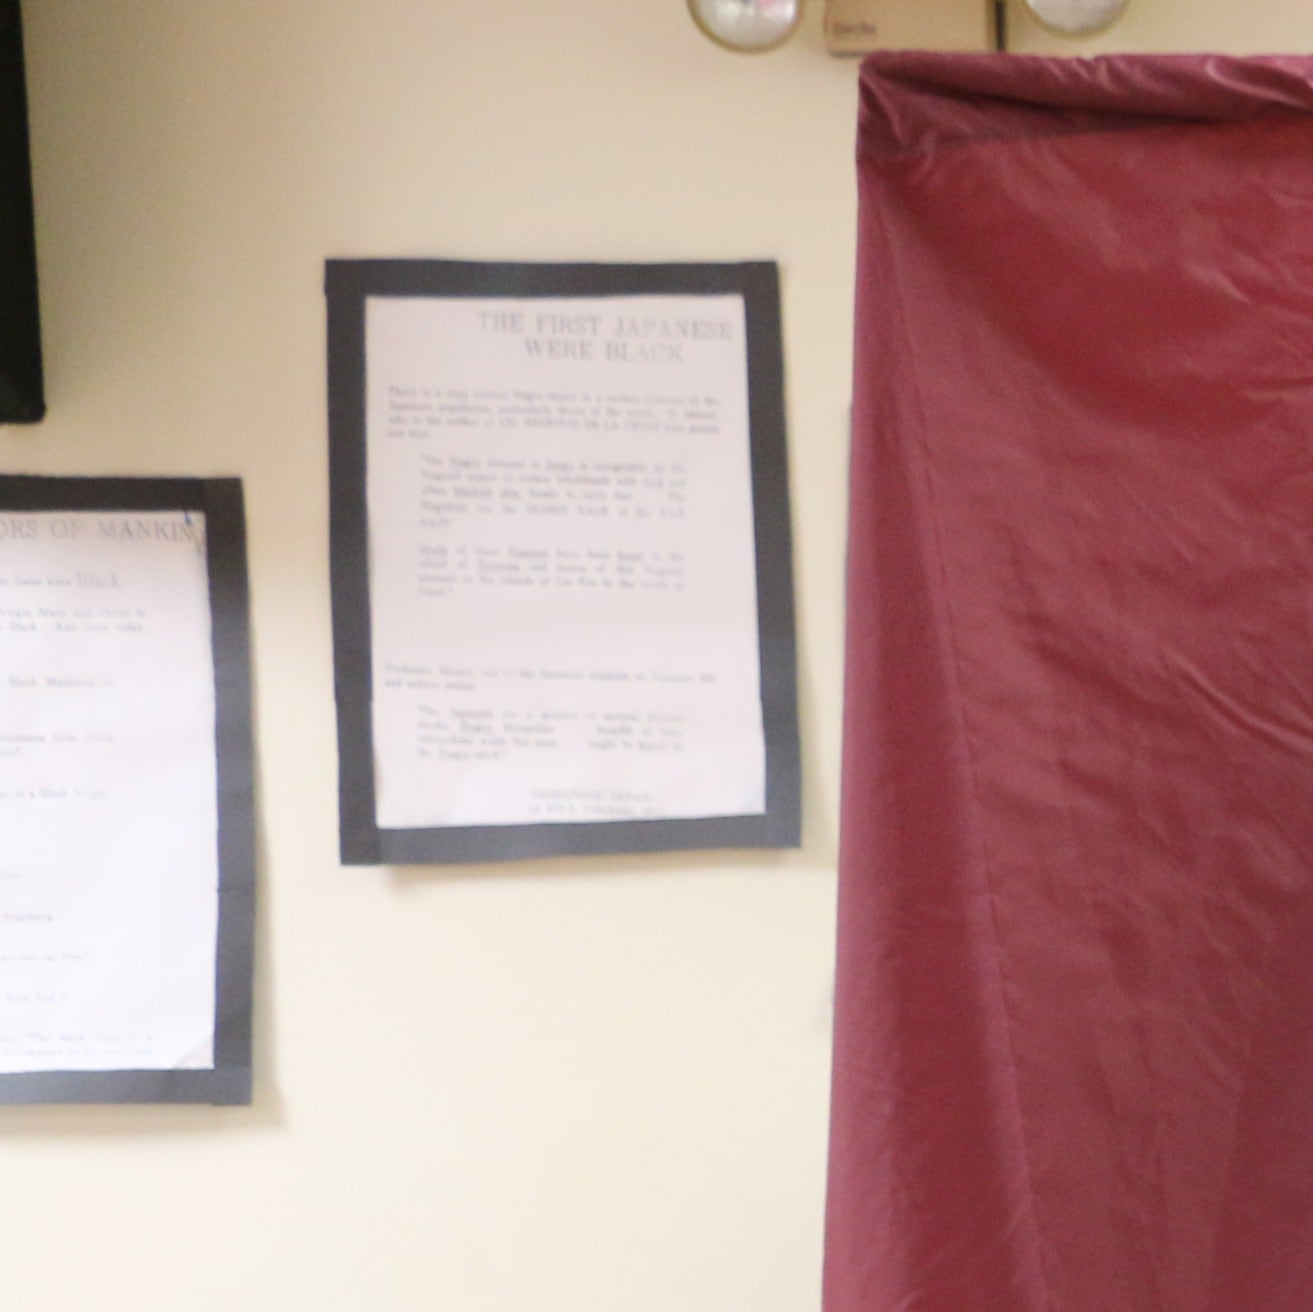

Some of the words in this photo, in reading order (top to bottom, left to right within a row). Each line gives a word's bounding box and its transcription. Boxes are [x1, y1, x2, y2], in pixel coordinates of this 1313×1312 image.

[478, 312, 524, 333] THE
[536, 314, 602, 336] FIRST
[614, 316, 733, 340] JAPANESE
[524, 337, 592, 360] WERE
[606, 340, 686, 364] BLACK
[50, 519, 81, 539] OF
